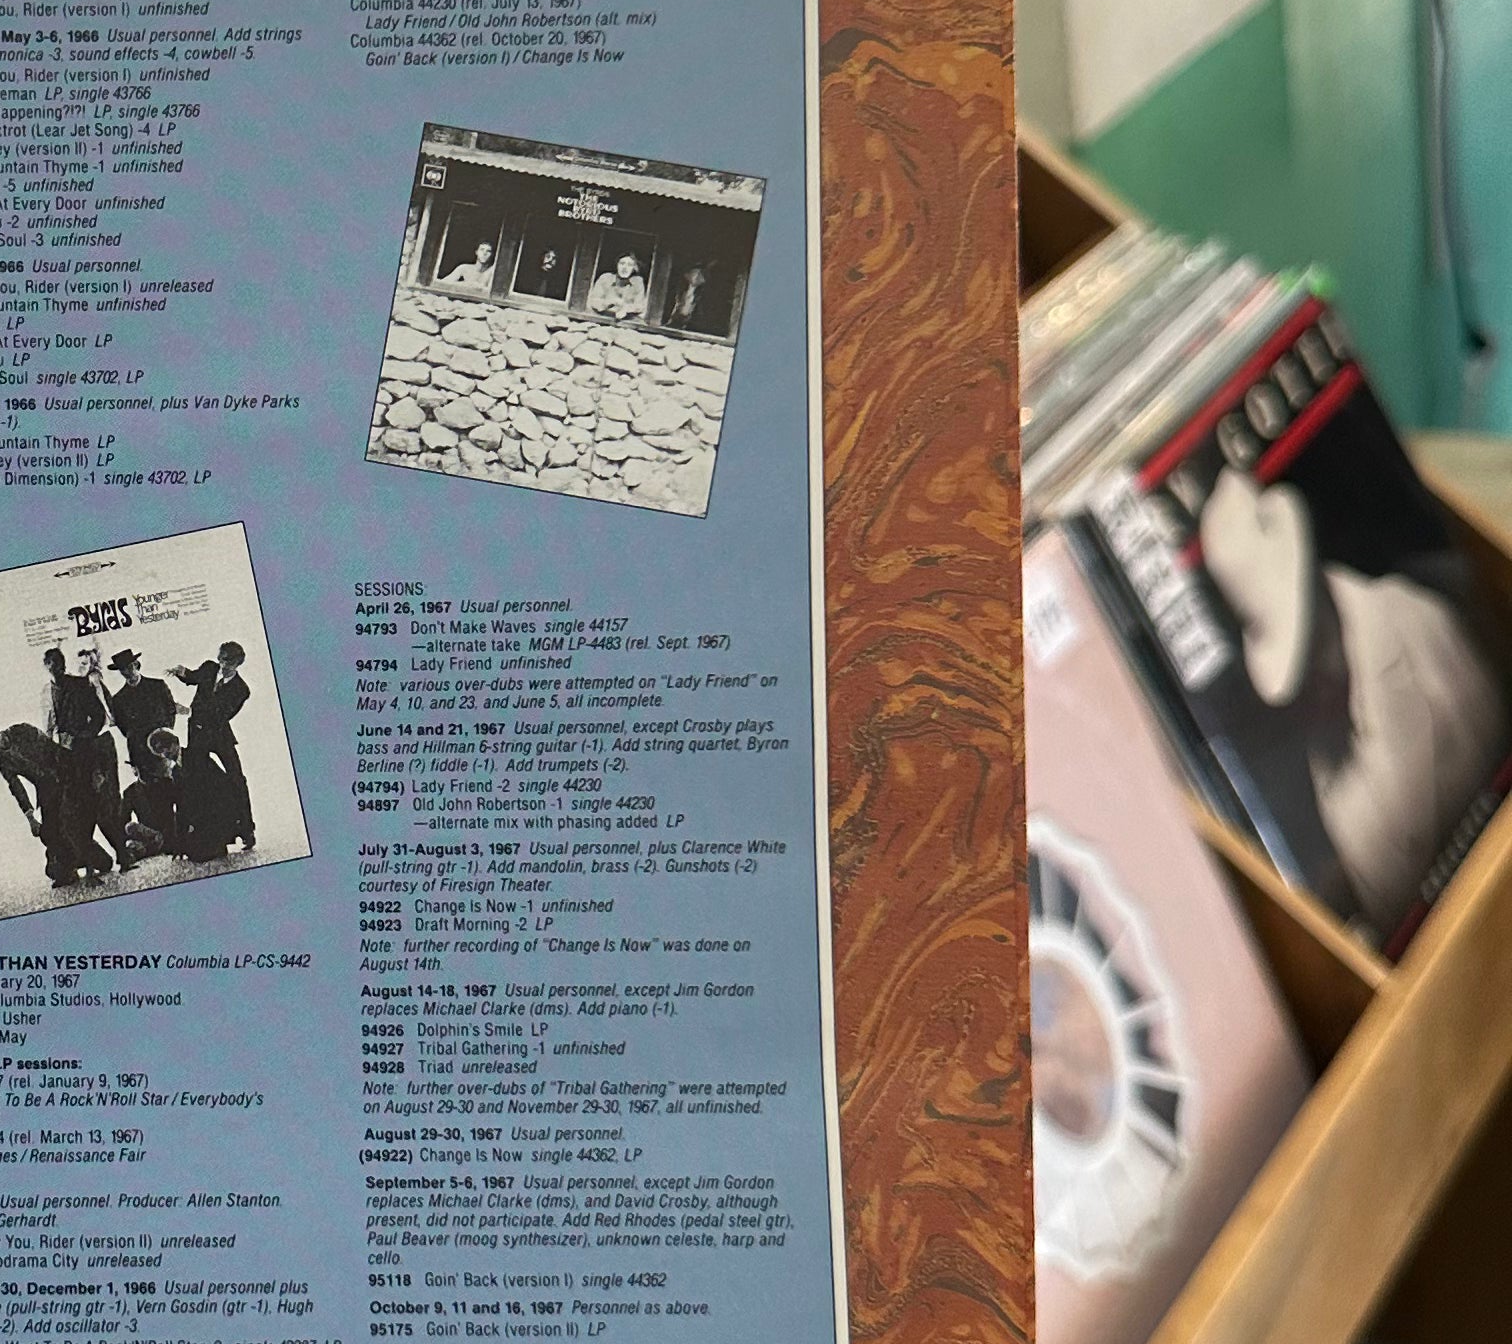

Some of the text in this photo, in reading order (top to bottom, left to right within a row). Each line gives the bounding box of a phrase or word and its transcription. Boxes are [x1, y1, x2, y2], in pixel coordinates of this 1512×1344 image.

[53, 953, 161, 970] YESTERDAY
[166, 954, 229, 968] Columbia
[234, 953, 310, 968] LP-CS-9442
